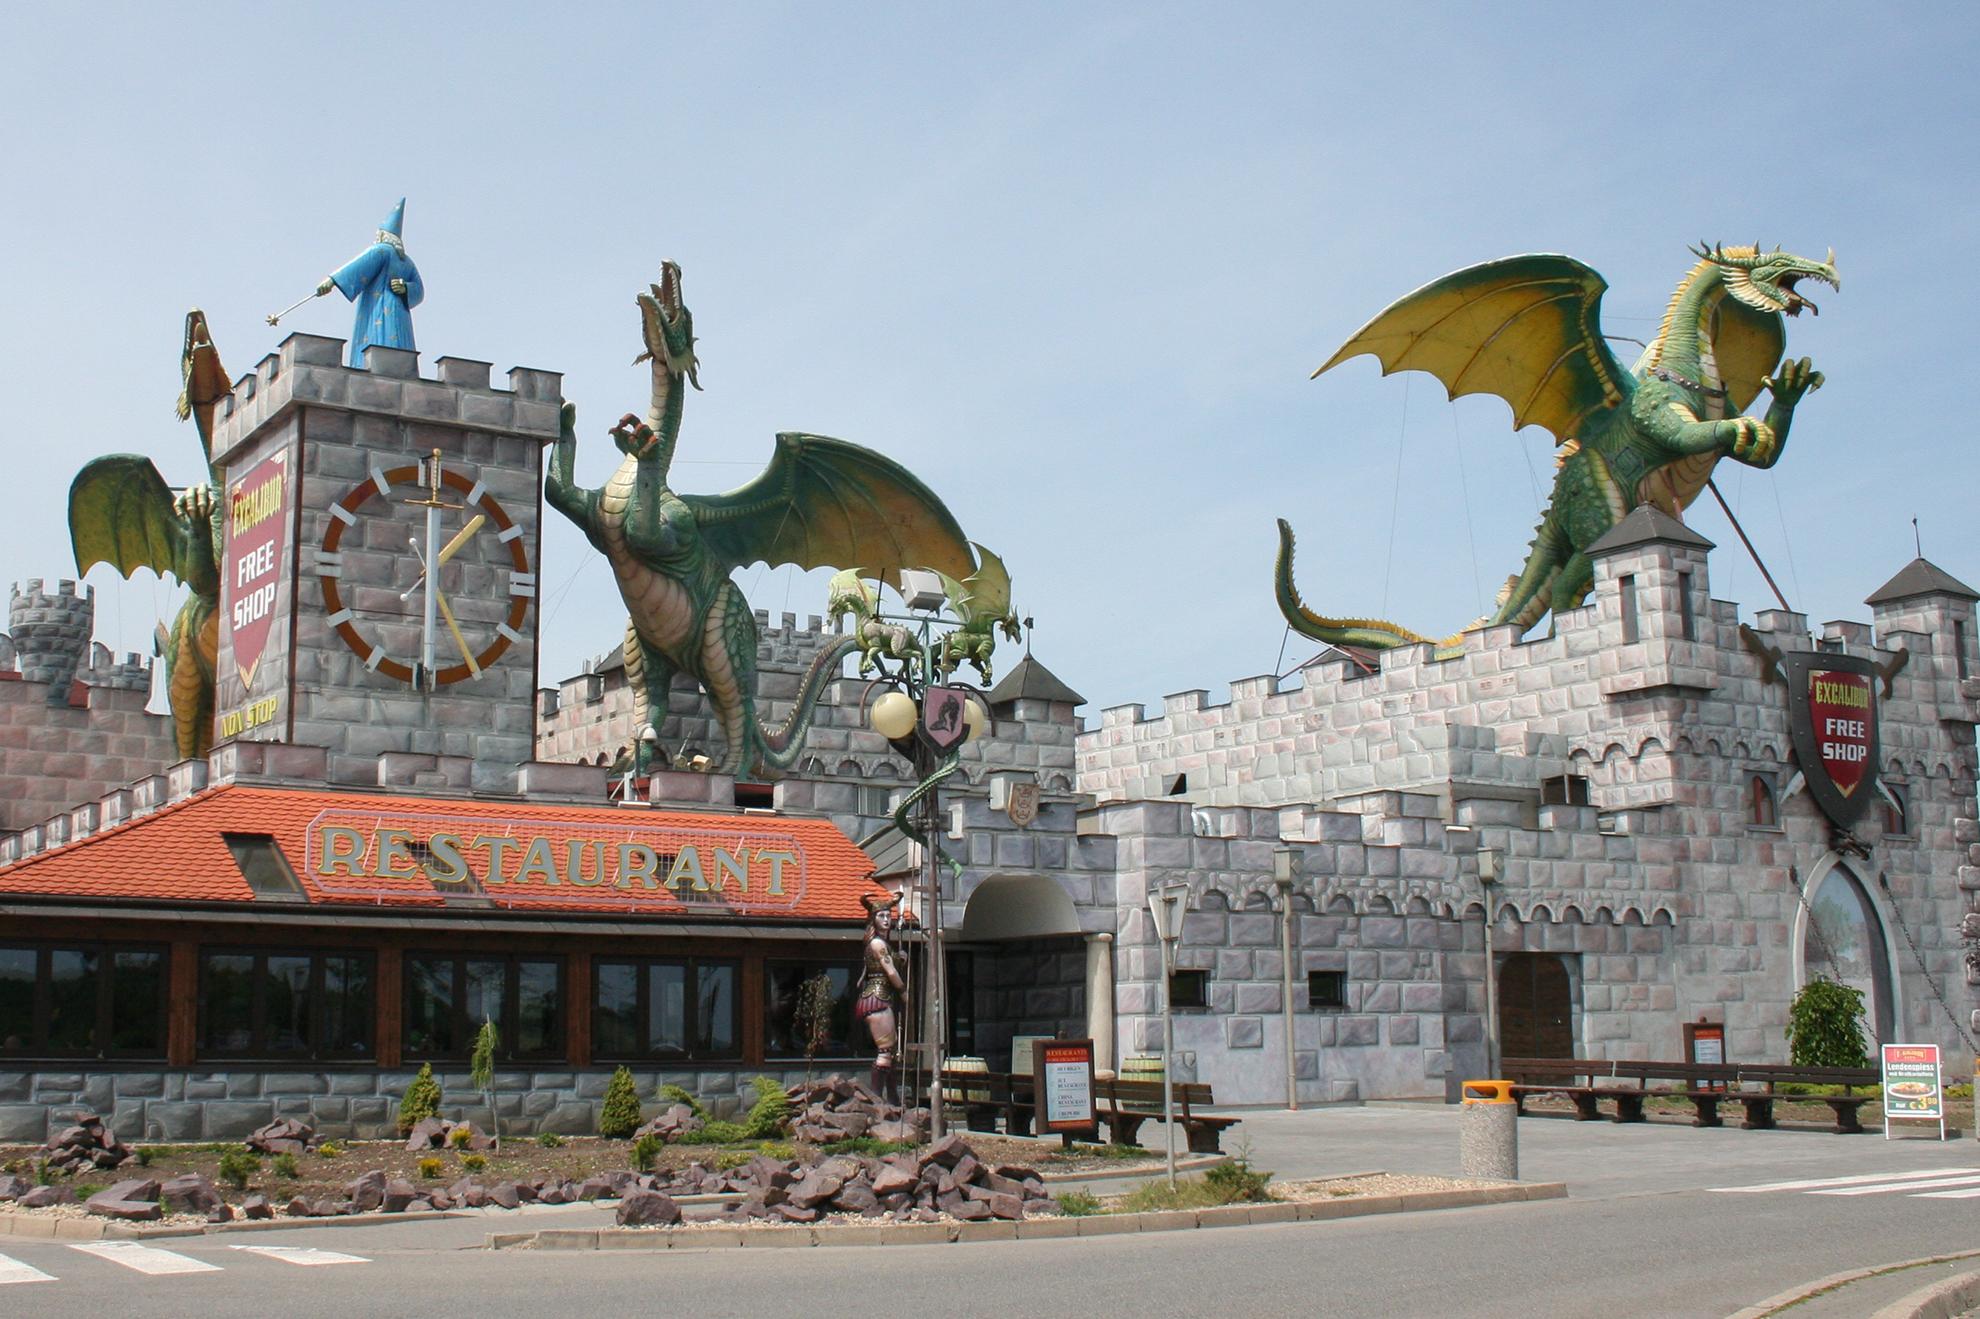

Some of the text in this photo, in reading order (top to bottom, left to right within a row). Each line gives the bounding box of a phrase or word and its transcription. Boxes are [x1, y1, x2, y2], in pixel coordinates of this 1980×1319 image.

[233, 472, 282, 539] EXCALIBUR
[237, 539, 275, 588] FREE
[233, 582, 275, 631] SHOP
[222, 695, 277, 738] NON STOP
[1815, 680, 1869, 709] EXCALIBUR
[1825, 718, 1865, 738] FREE
[1822, 742, 1867, 762] SHOP
[317, 826, 798, 896] RESTAURANT
